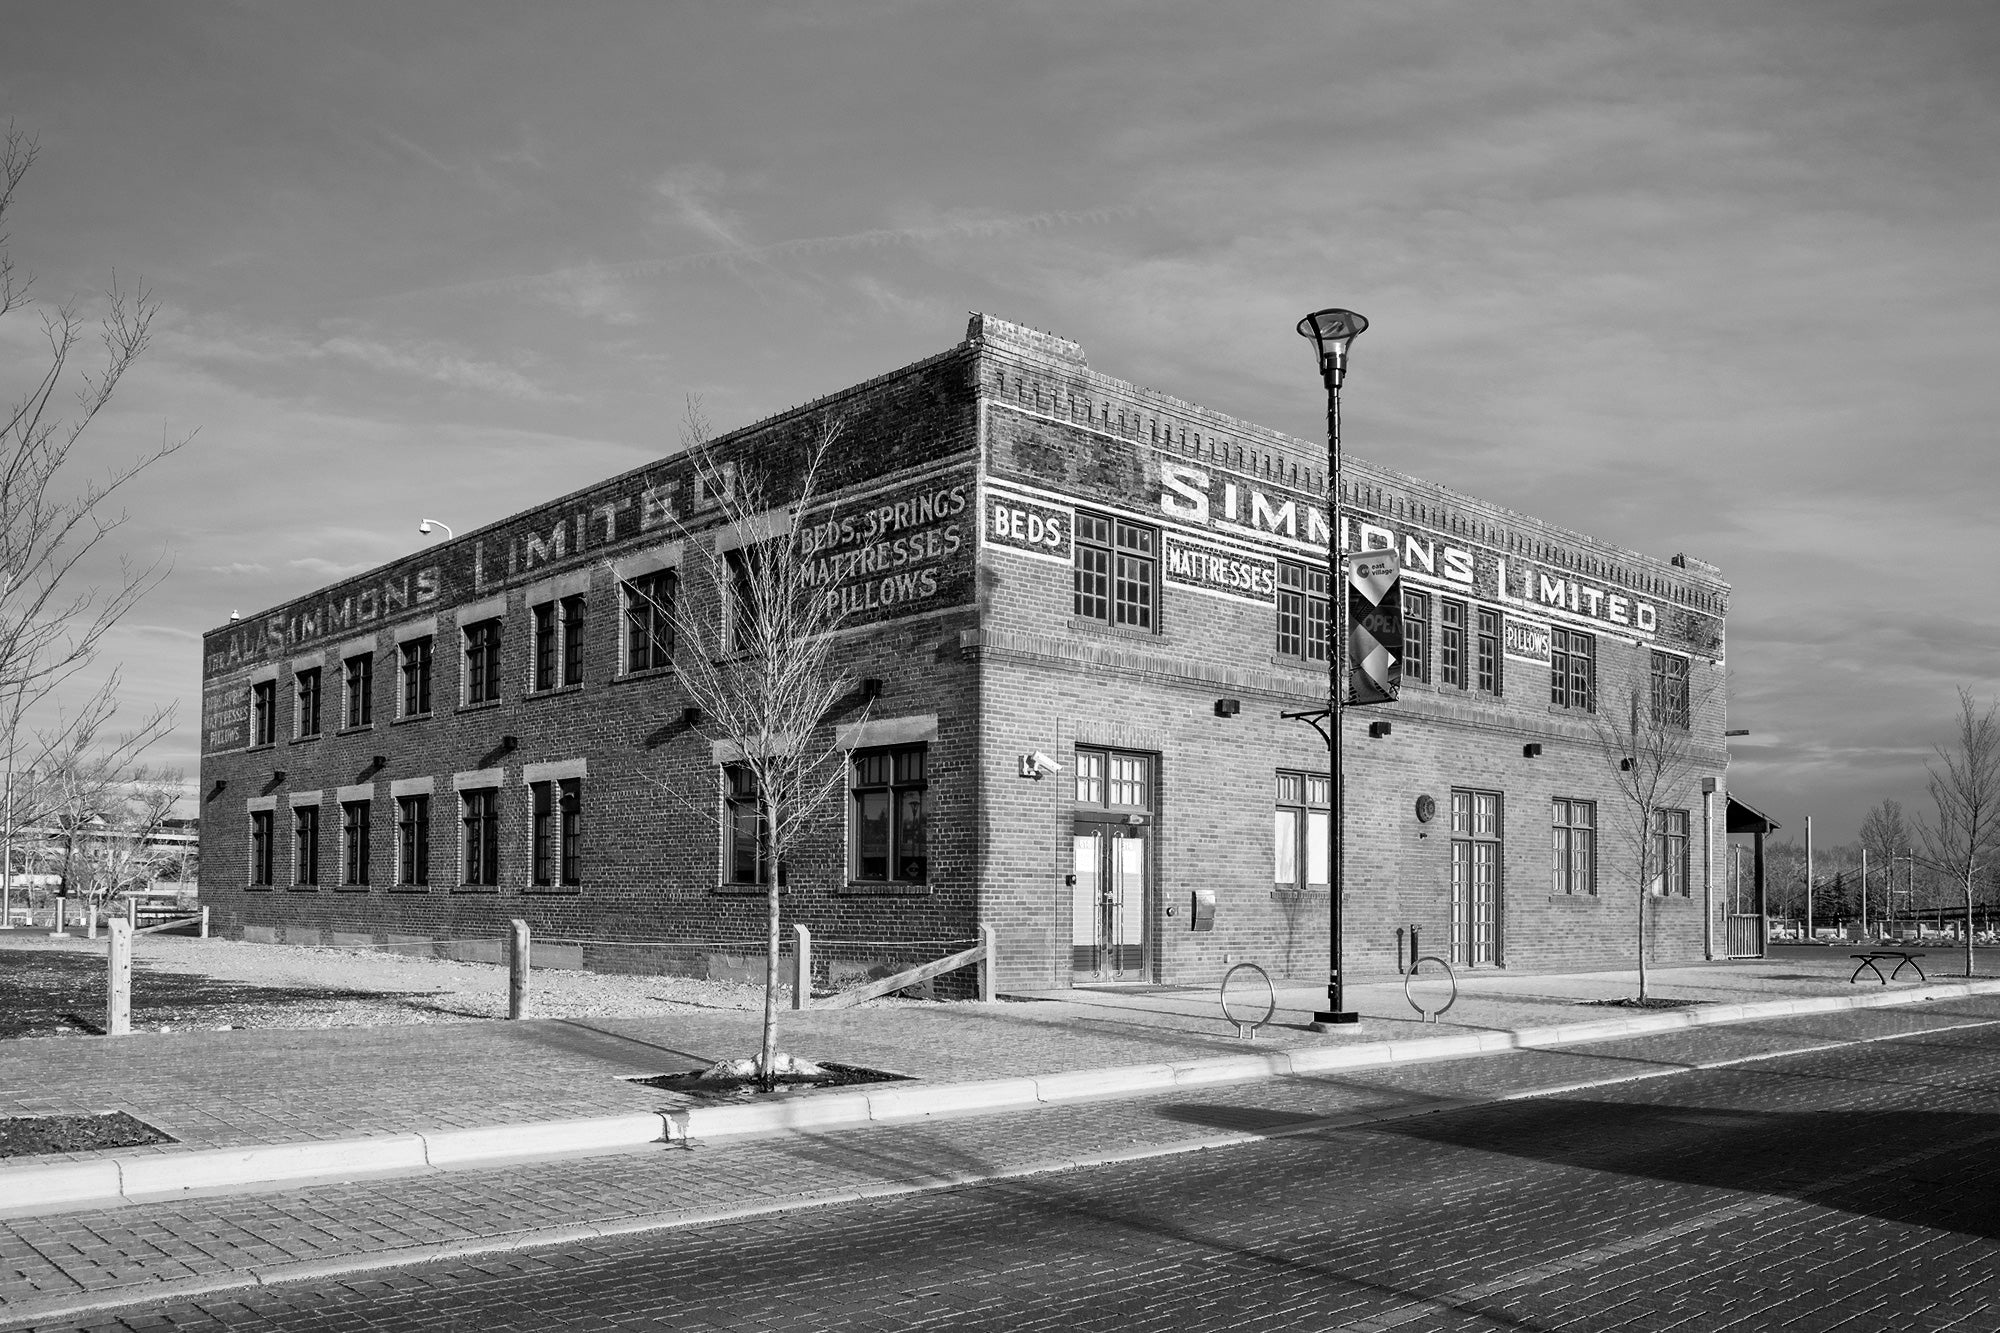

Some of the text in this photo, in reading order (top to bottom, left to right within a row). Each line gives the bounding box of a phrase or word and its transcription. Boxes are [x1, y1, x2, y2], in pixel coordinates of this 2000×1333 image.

[475, 462, 735, 595] LIMITED
[864, 484, 966, 539] SPRINGS
[994, 505, 1062, 548] BEDS
[800, 524, 961, 589] MATTRESSES
[1160, 462, 1657, 633] SIMMONS LIMITED
[1168, 546, 1274, 596] MATTRESSES
[1371, 568, 1393, 576] village
[826, 567, 938, 617] PILLOWS
[1362, 614, 1402, 635] OPEN
[1505, 624, 1550, 656] PILLOWS
